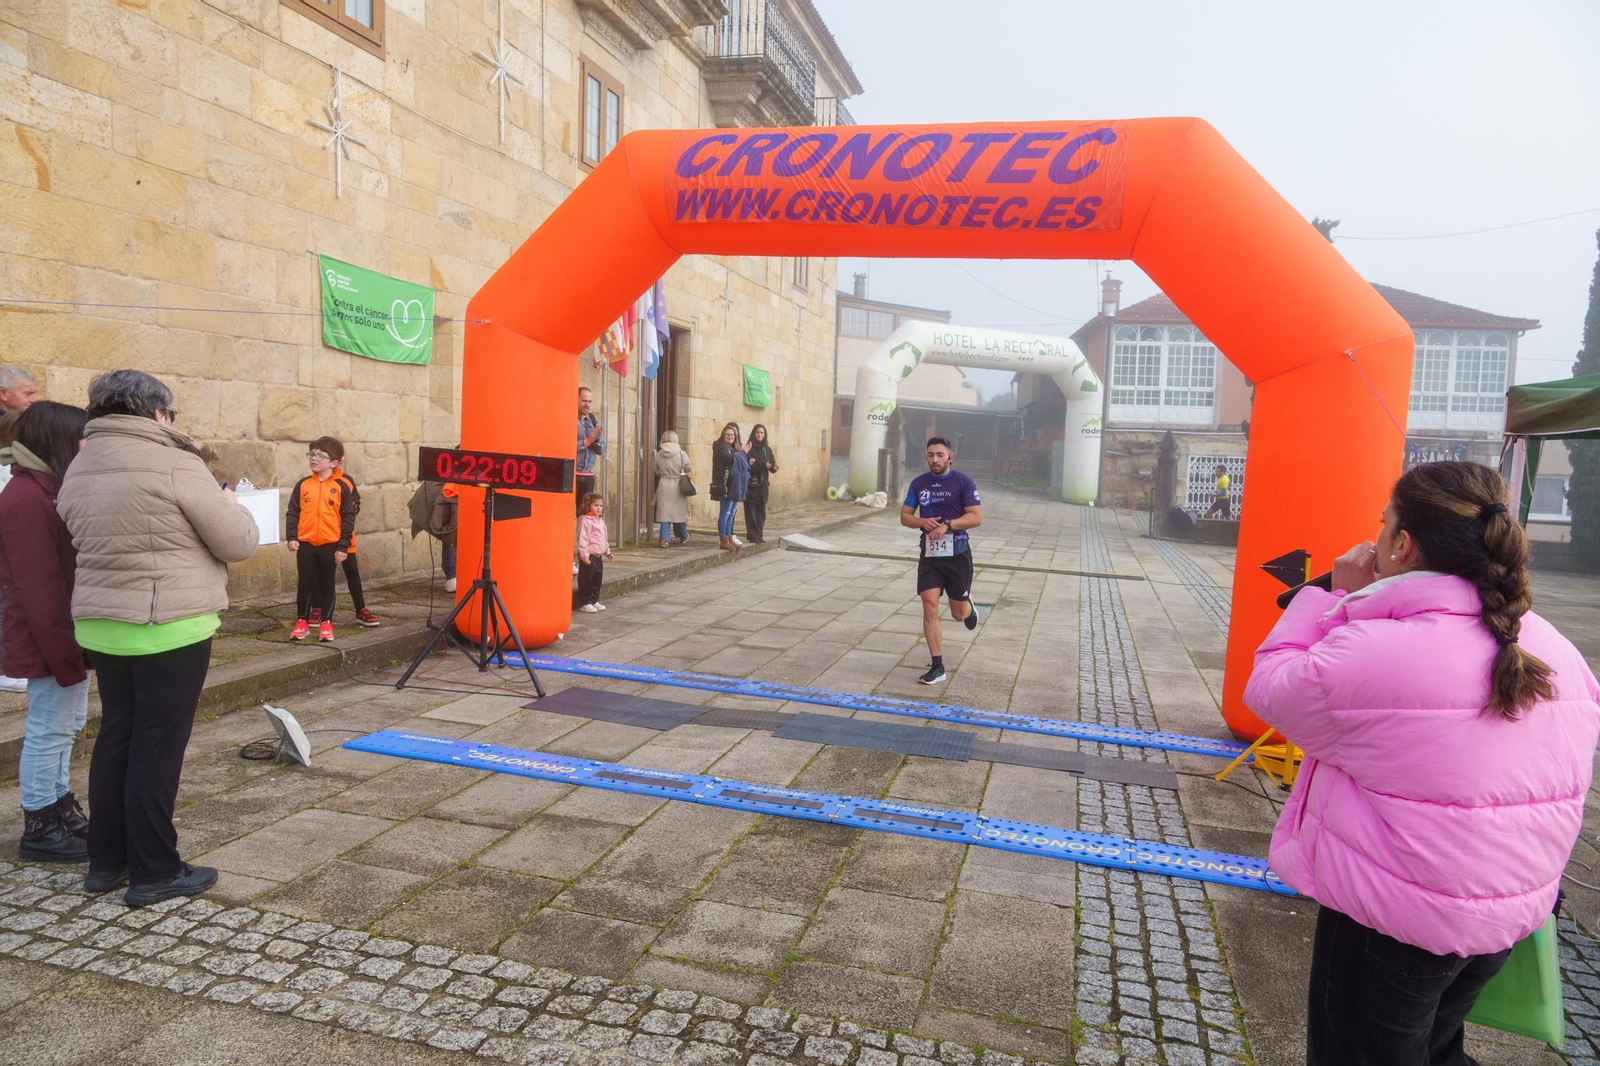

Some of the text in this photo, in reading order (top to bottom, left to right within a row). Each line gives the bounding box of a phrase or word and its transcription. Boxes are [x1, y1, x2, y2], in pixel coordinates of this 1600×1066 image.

[676, 128, 1117, 185] CRONOTEC
[675, 188, 1102, 229] WWW.CRONOTEC.ES
[355, 304, 364, 315] el
[933, 331, 977, 349] HOTEL
[985, 337, 1000, 352] LA
[931, 349, 1010, 363] www.hotelrectoral.com
[436, 453, 537, 486] 0:22:09
[920, 489, 931, 500] 21
[930, 541, 947, 551] 514
[1048, 724, 1143, 741] CRONOTEC
[1154, 736, 1243, 753] RONOTEC
[468, 752, 577, 774] CRONOTEC
[624, 767, 684, 779] CRONOTEC
[748, 785, 810, 797] CRONOTEC
[878, 803, 946, 817] CRONOTEC
[985, 829, 1122, 856] CRONOTEC
